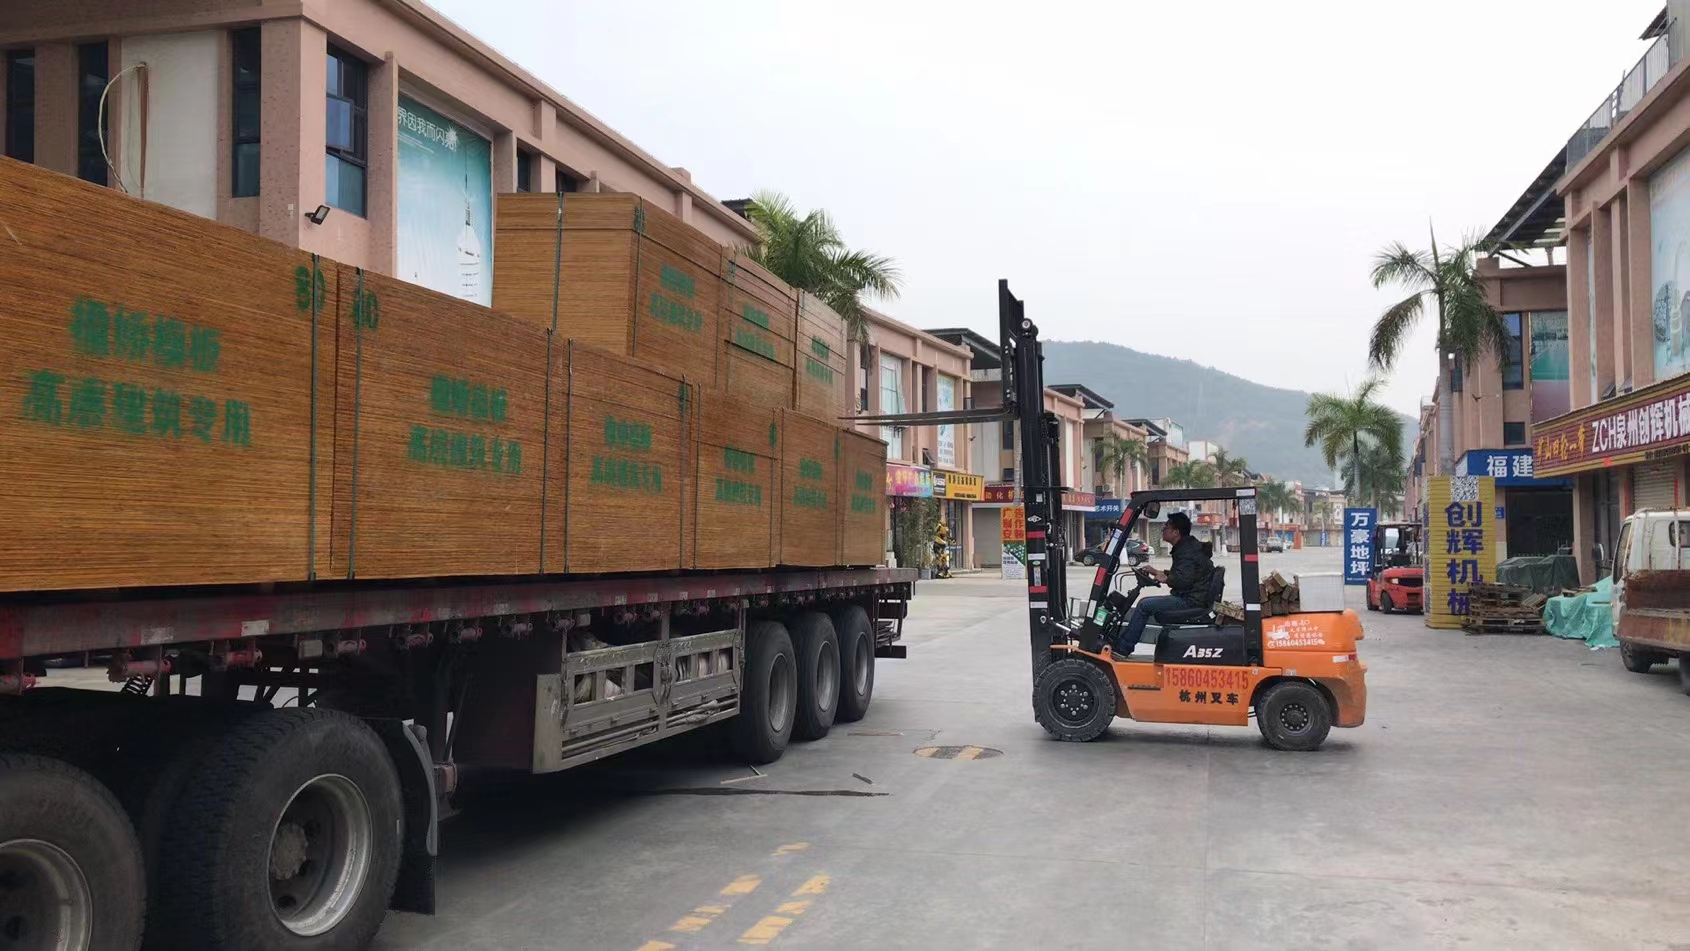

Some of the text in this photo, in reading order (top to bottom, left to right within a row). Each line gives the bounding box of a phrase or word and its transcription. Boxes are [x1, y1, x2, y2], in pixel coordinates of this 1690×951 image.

[1487, 455, 1533, 478] 福建
[1350, 512, 1370, 576] 万豪地坪
[1166, 667, 1249, 690] 15860453415
[1179, 690, 1239, 705] 杭州叉车
